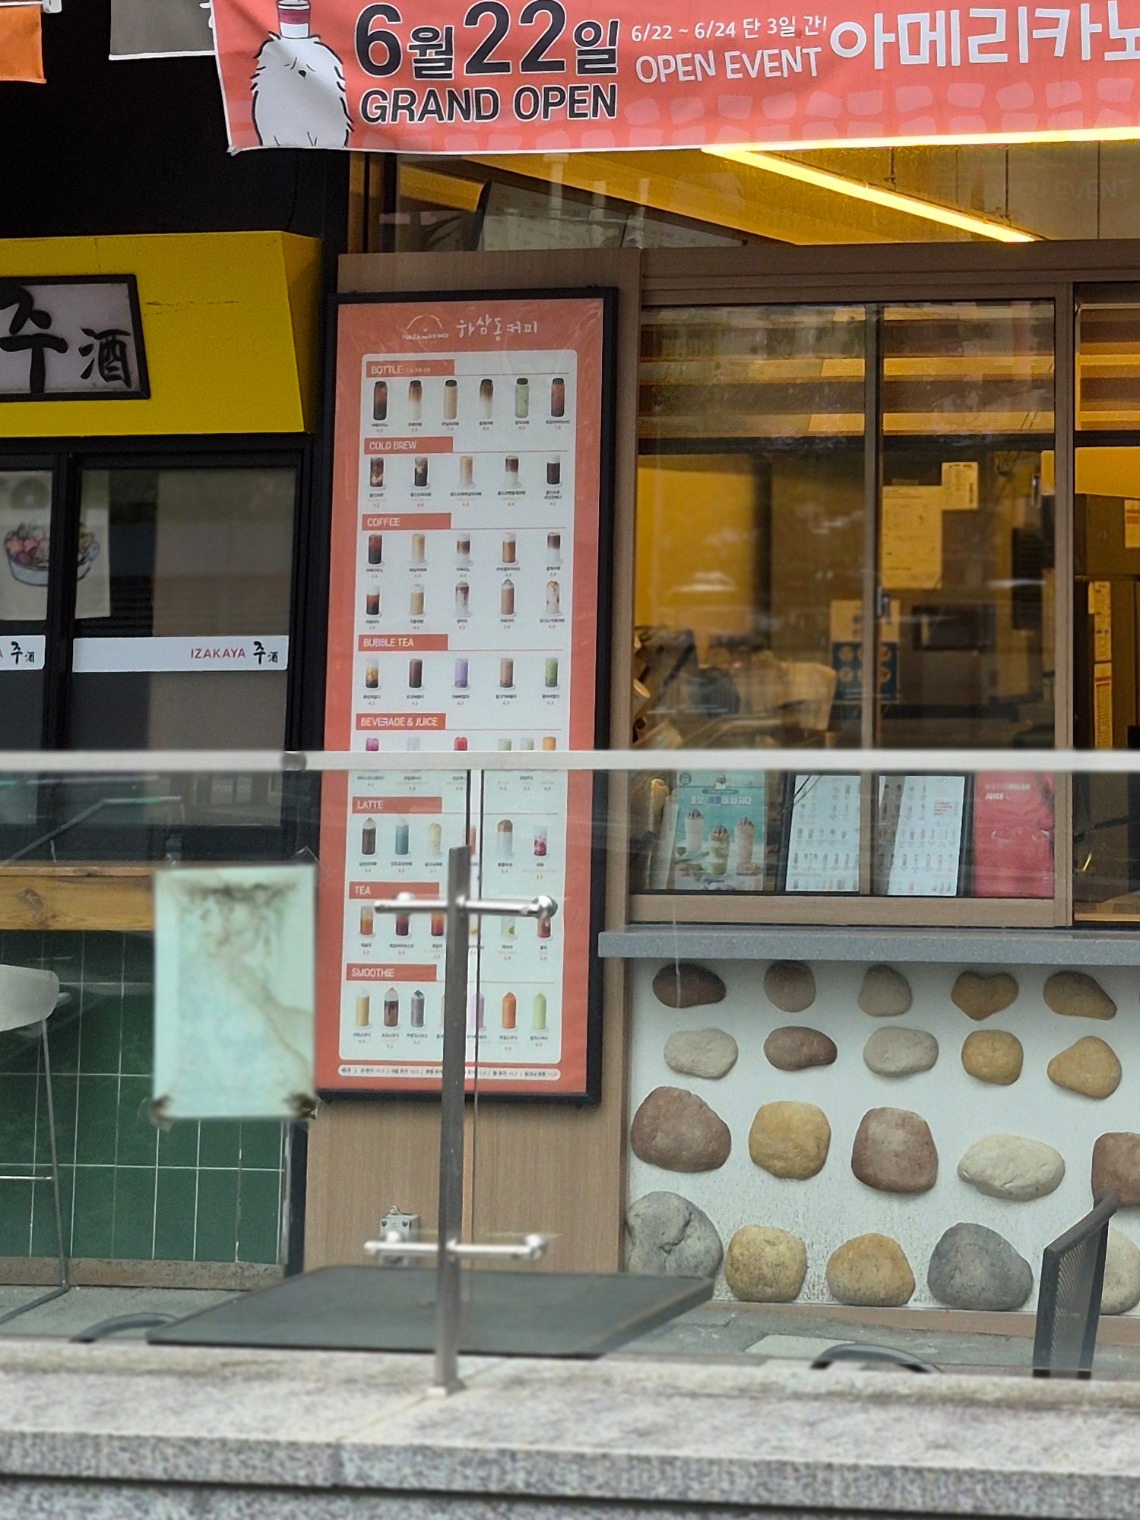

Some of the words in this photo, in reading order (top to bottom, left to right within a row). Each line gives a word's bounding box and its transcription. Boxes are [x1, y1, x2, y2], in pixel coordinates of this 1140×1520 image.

[631, 23, 674, 42] 6/22
[694, 20, 737, 40] 6/24
[743, 17, 762, 39] 단
[767, 15, 796, 38] 3일
[635, 50, 716, 84] OPEN
[724, 45, 823, 80] EVENT
[360, 87, 501, 124] GRAND
[513, 83, 618, 122] OPEN
[371, 366, 403, 376] BOTTLE
[369, 441, 392, 451] COLD
[367, 517, 400, 527] COFFEE
[363, 638, 398, 648] BUBBLE
[398, 637, 414, 647] TEA
[190, 648, 247, 660] IZAKAYA
[361, 717, 406, 727] BEVERAGE
[415, 717, 438, 727] JUICE
[357, 800, 384, 810] LATTE
[354, 885, 371, 896] TEA
[351, 967, 395, 978] SMOOTHIE
